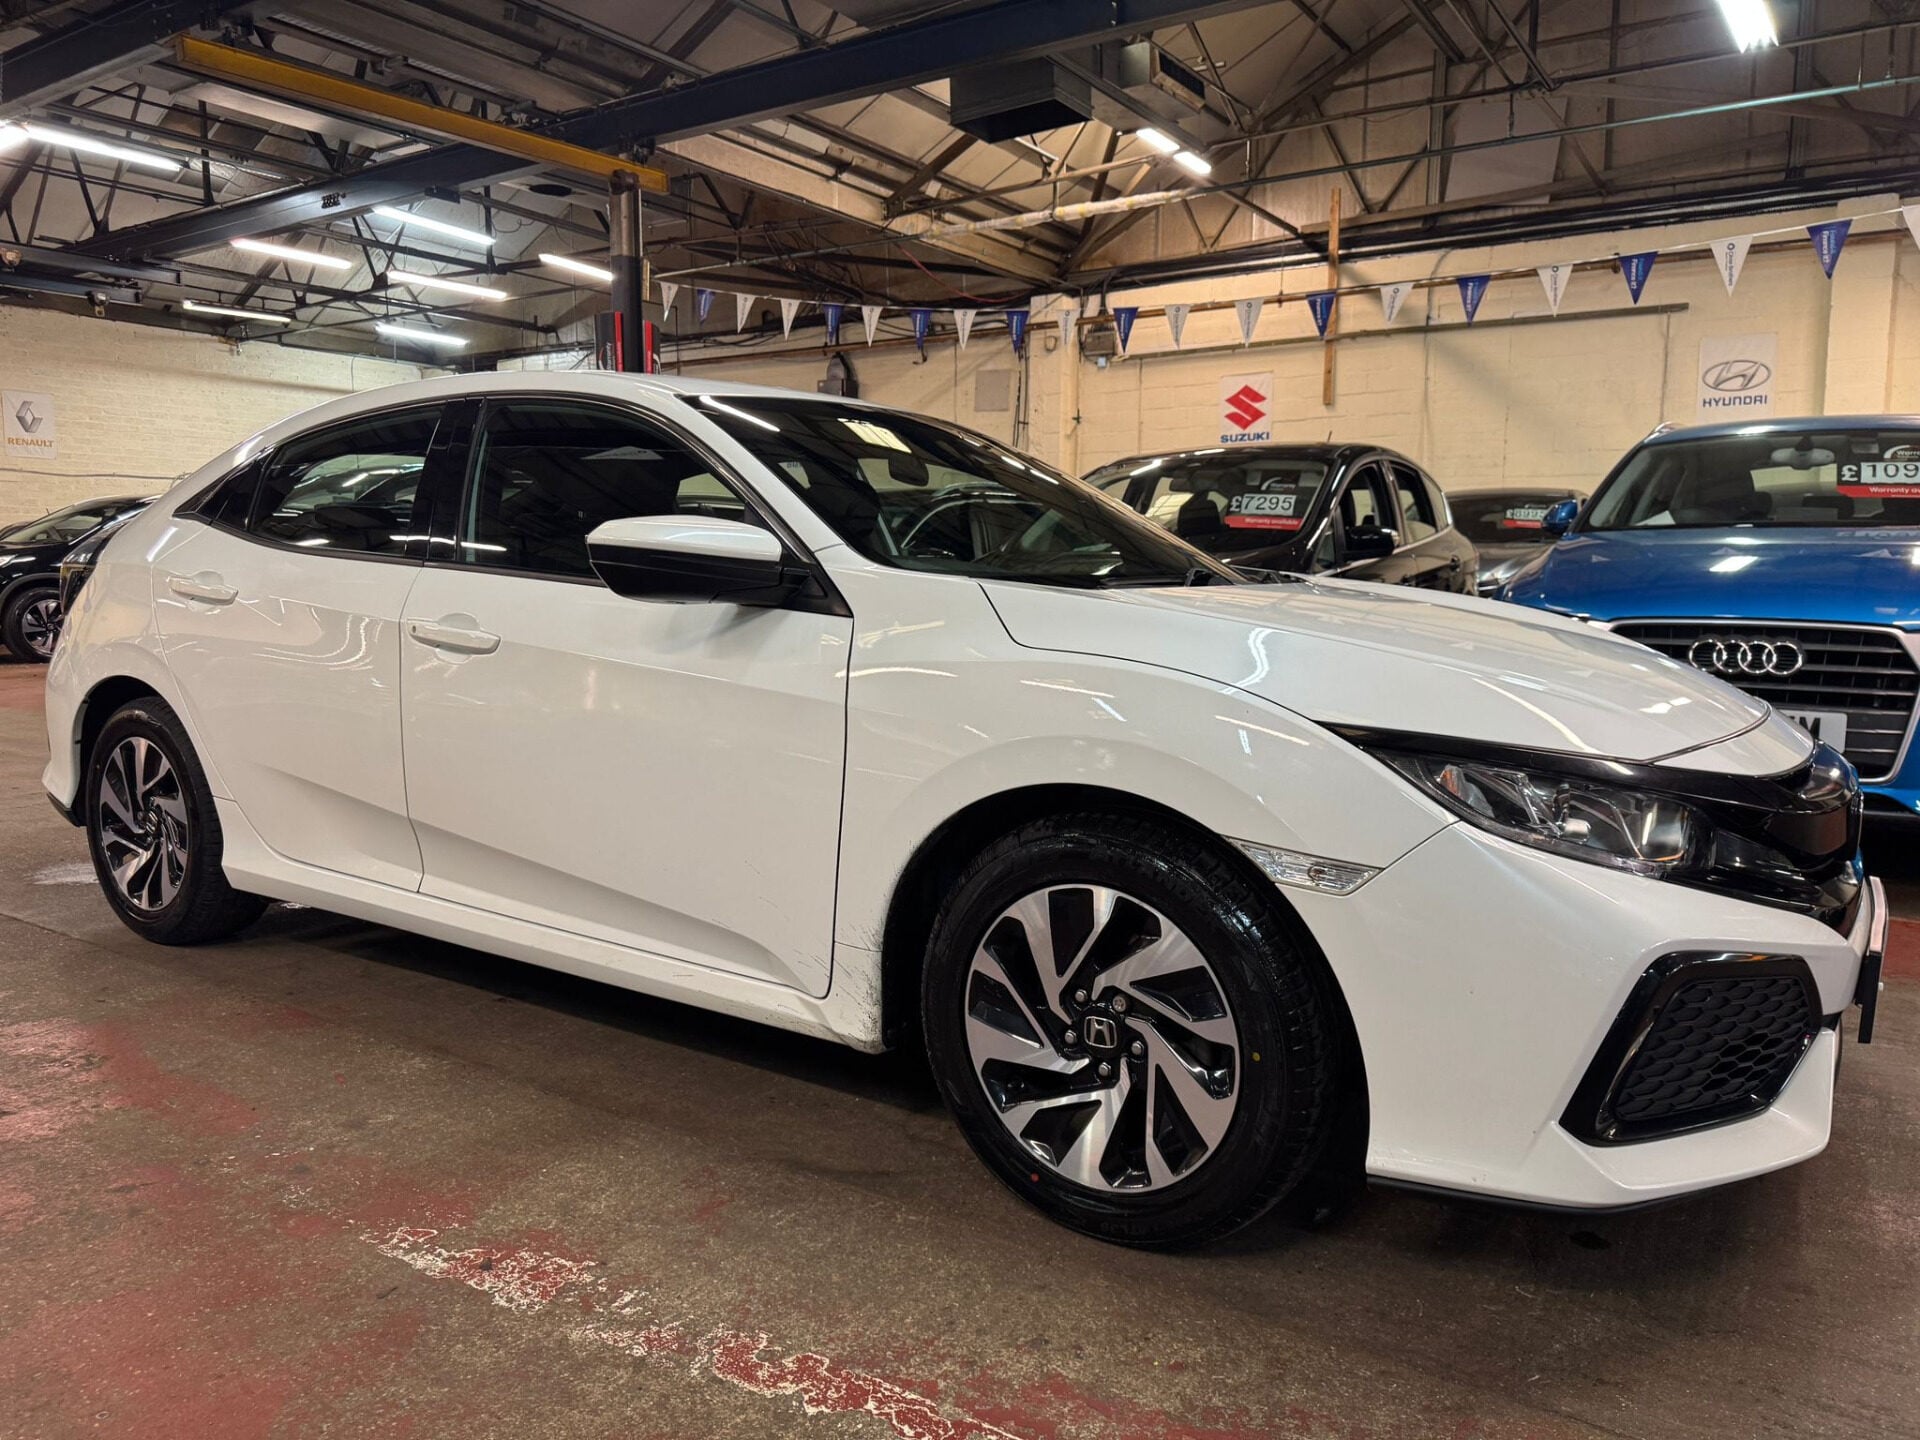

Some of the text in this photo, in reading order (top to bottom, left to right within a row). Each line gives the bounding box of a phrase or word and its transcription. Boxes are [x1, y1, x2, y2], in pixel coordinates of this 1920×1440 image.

[1702, 395, 1768, 408] HYUNDAI
[7, 437, 54, 448] RENAULT
[1220, 432, 1270, 443] SUZUKI
[1229, 495, 1293, 511] £7295
